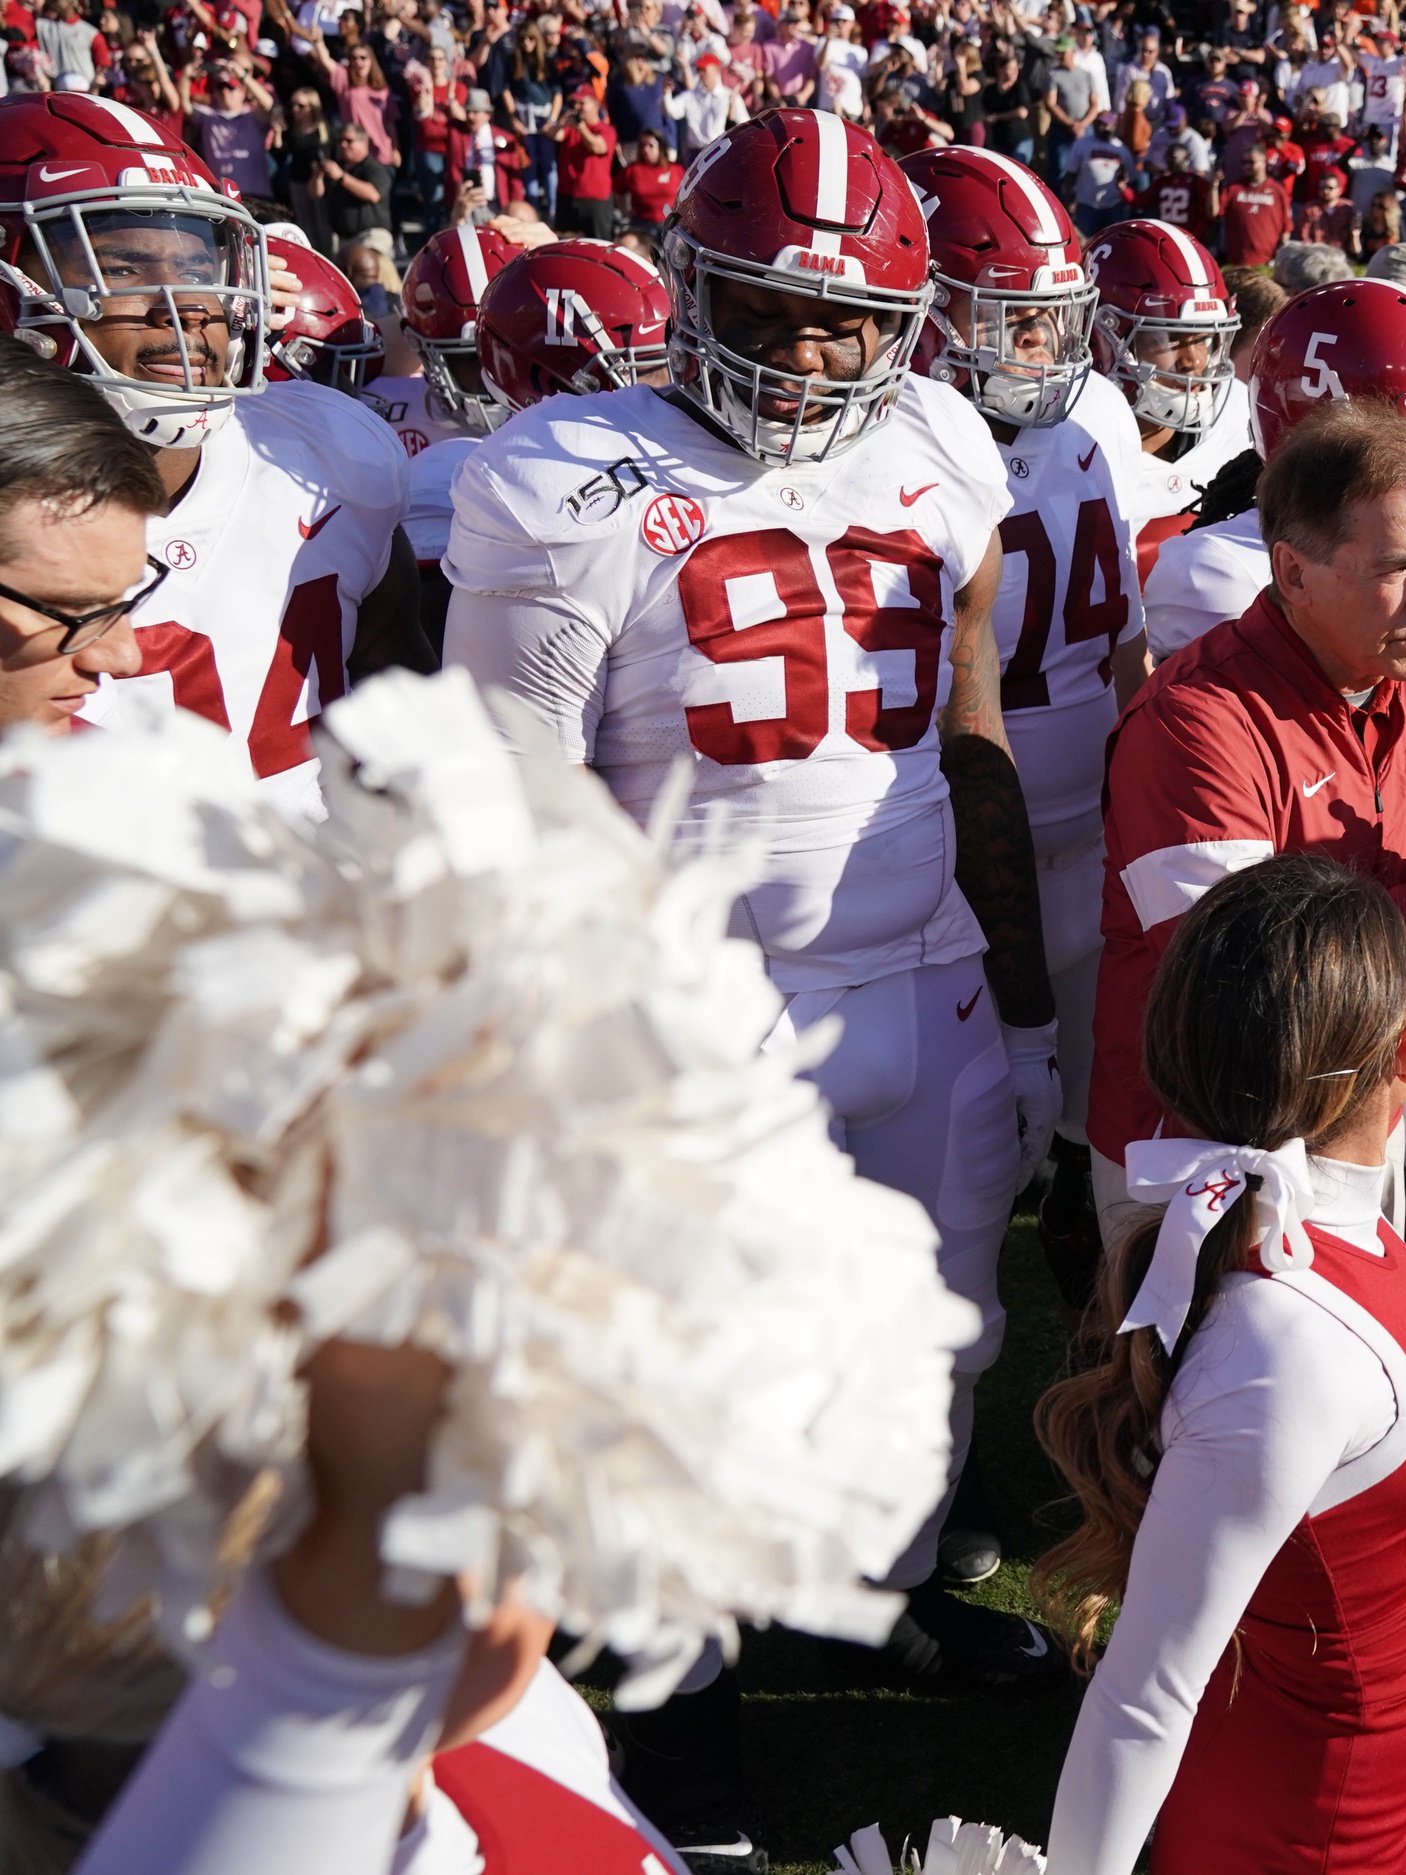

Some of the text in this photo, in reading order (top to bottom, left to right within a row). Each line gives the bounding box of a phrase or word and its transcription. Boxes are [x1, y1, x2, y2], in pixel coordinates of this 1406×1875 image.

[148, 166, 199, 189] BAMA
[1159, 186, 1191, 223] 22
[799, 251, 846, 276] BAMA
[1053, 268, 1079, 284] BAMA
[544, 288, 578, 347] 11
[1194, 301, 1219, 312] BAMA
[1301, 331, 1338, 398] 5
[187, 408, 208, 430] A
[566, 456, 649, 522] 150
[646, 494, 702, 553] SEC
[678, 524, 946, 766] 99
[1185, 1169, 1241, 1212] A
